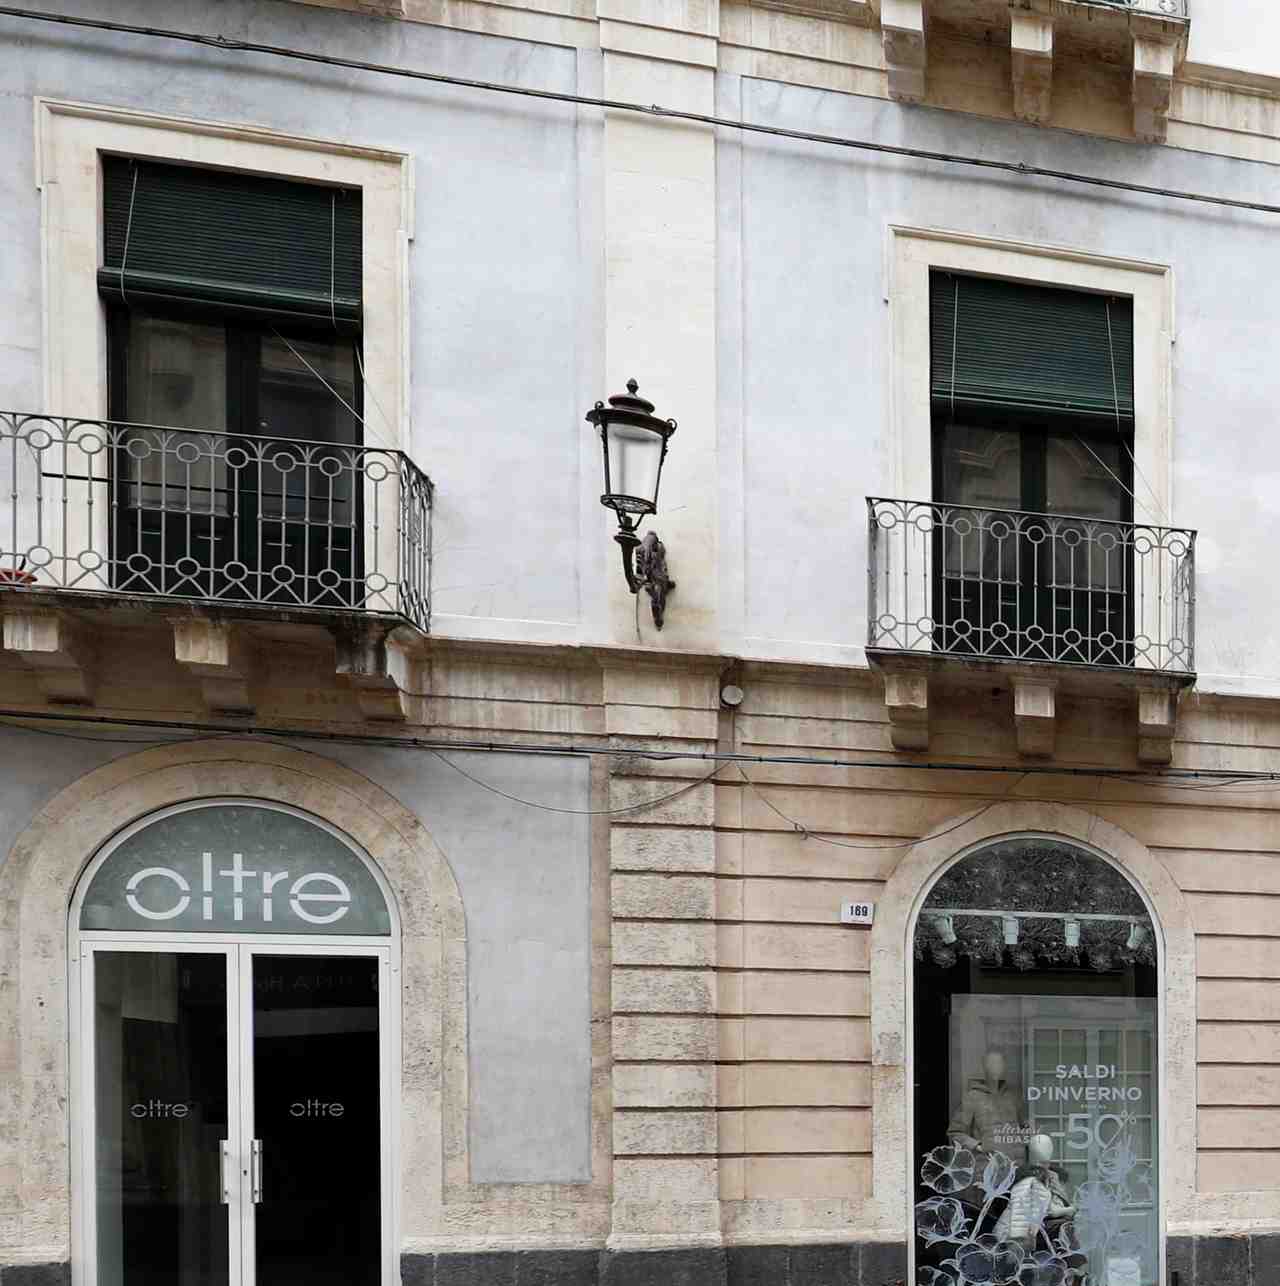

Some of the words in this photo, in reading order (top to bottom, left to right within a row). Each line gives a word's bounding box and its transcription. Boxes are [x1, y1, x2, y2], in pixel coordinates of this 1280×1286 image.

[126, 852, 351, 924] oltre
[1055, 1064, 1116, 1079] SALDI
[1027, 1086, 1143, 1101] D'INVERNO
[130, 1099, 190, 1118] oltre
[289, 1099, 345, 1117] oltre
